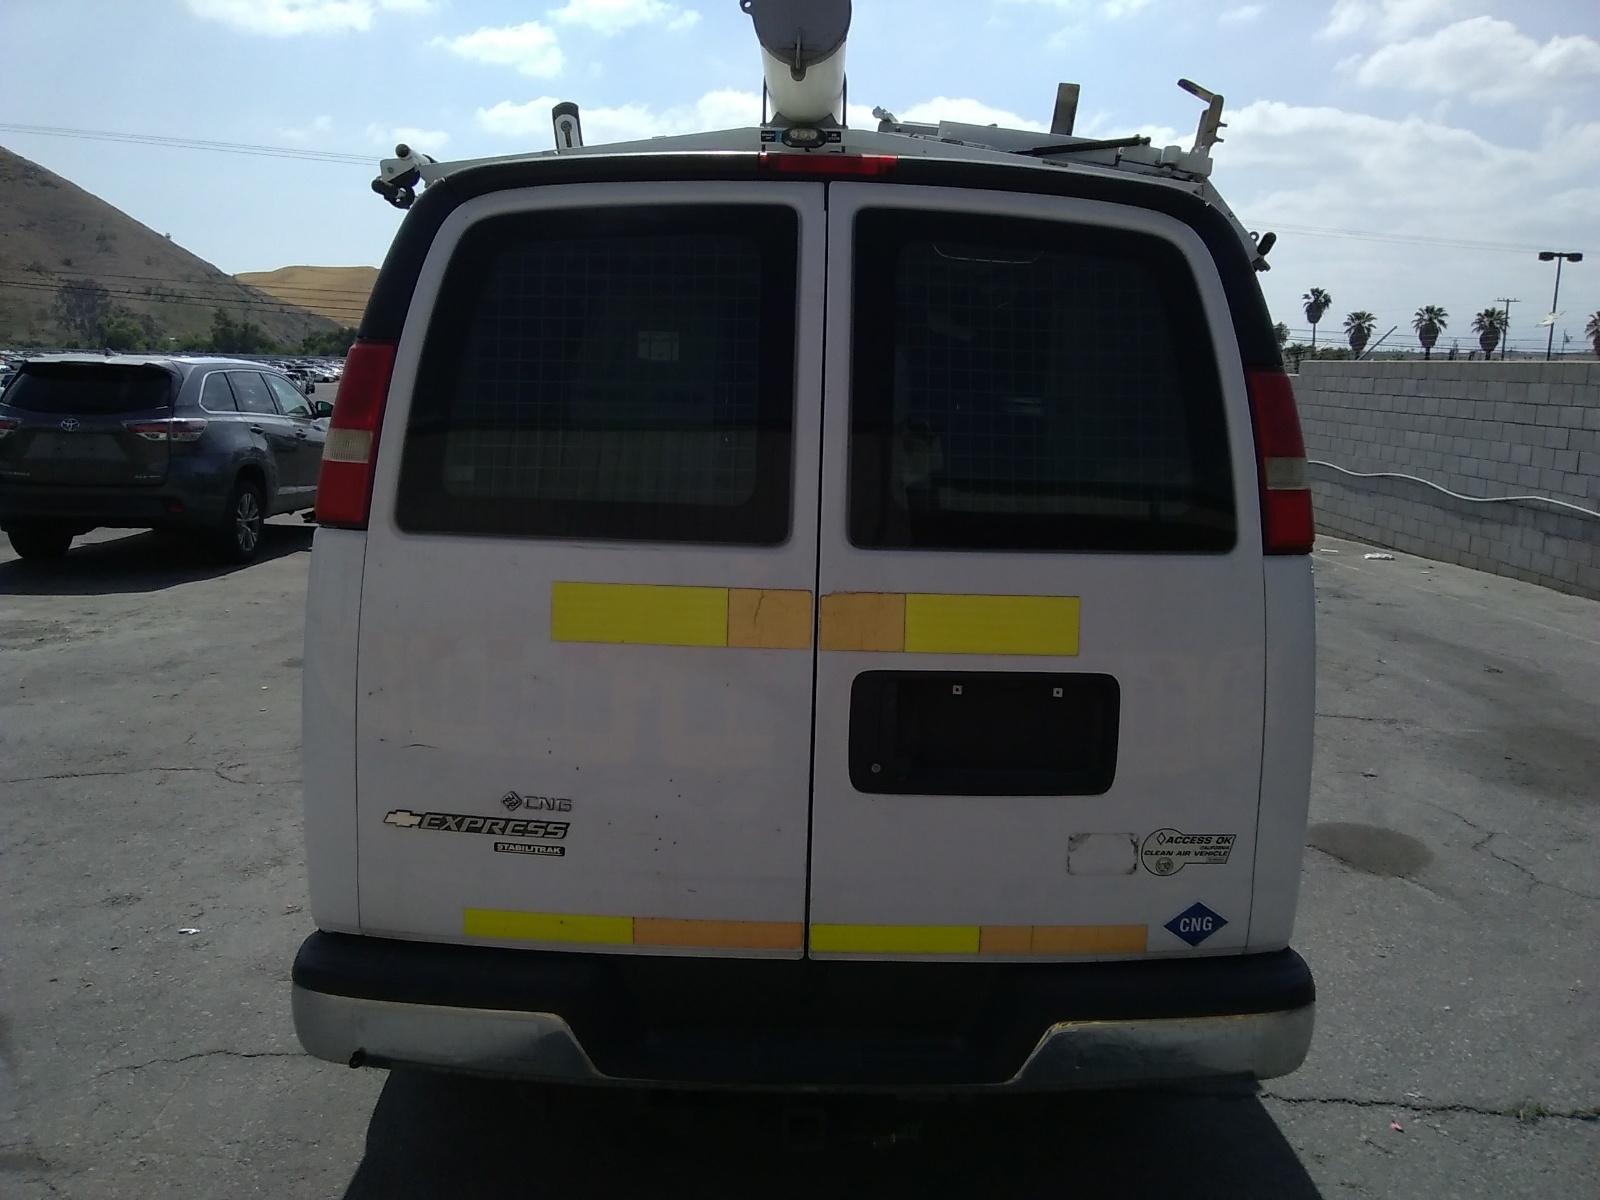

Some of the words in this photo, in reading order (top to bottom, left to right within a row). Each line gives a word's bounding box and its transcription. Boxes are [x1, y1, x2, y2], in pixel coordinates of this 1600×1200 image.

[523, 795, 572, 812] CNG
[420, 812, 569, 839] EXPRESS
[496, 843, 562, 854] STABILITRAK
[1165, 836, 1212, 844] ACCESS
[1215, 836, 1233, 844] OK
[1179, 916, 1213, 933] CNG
